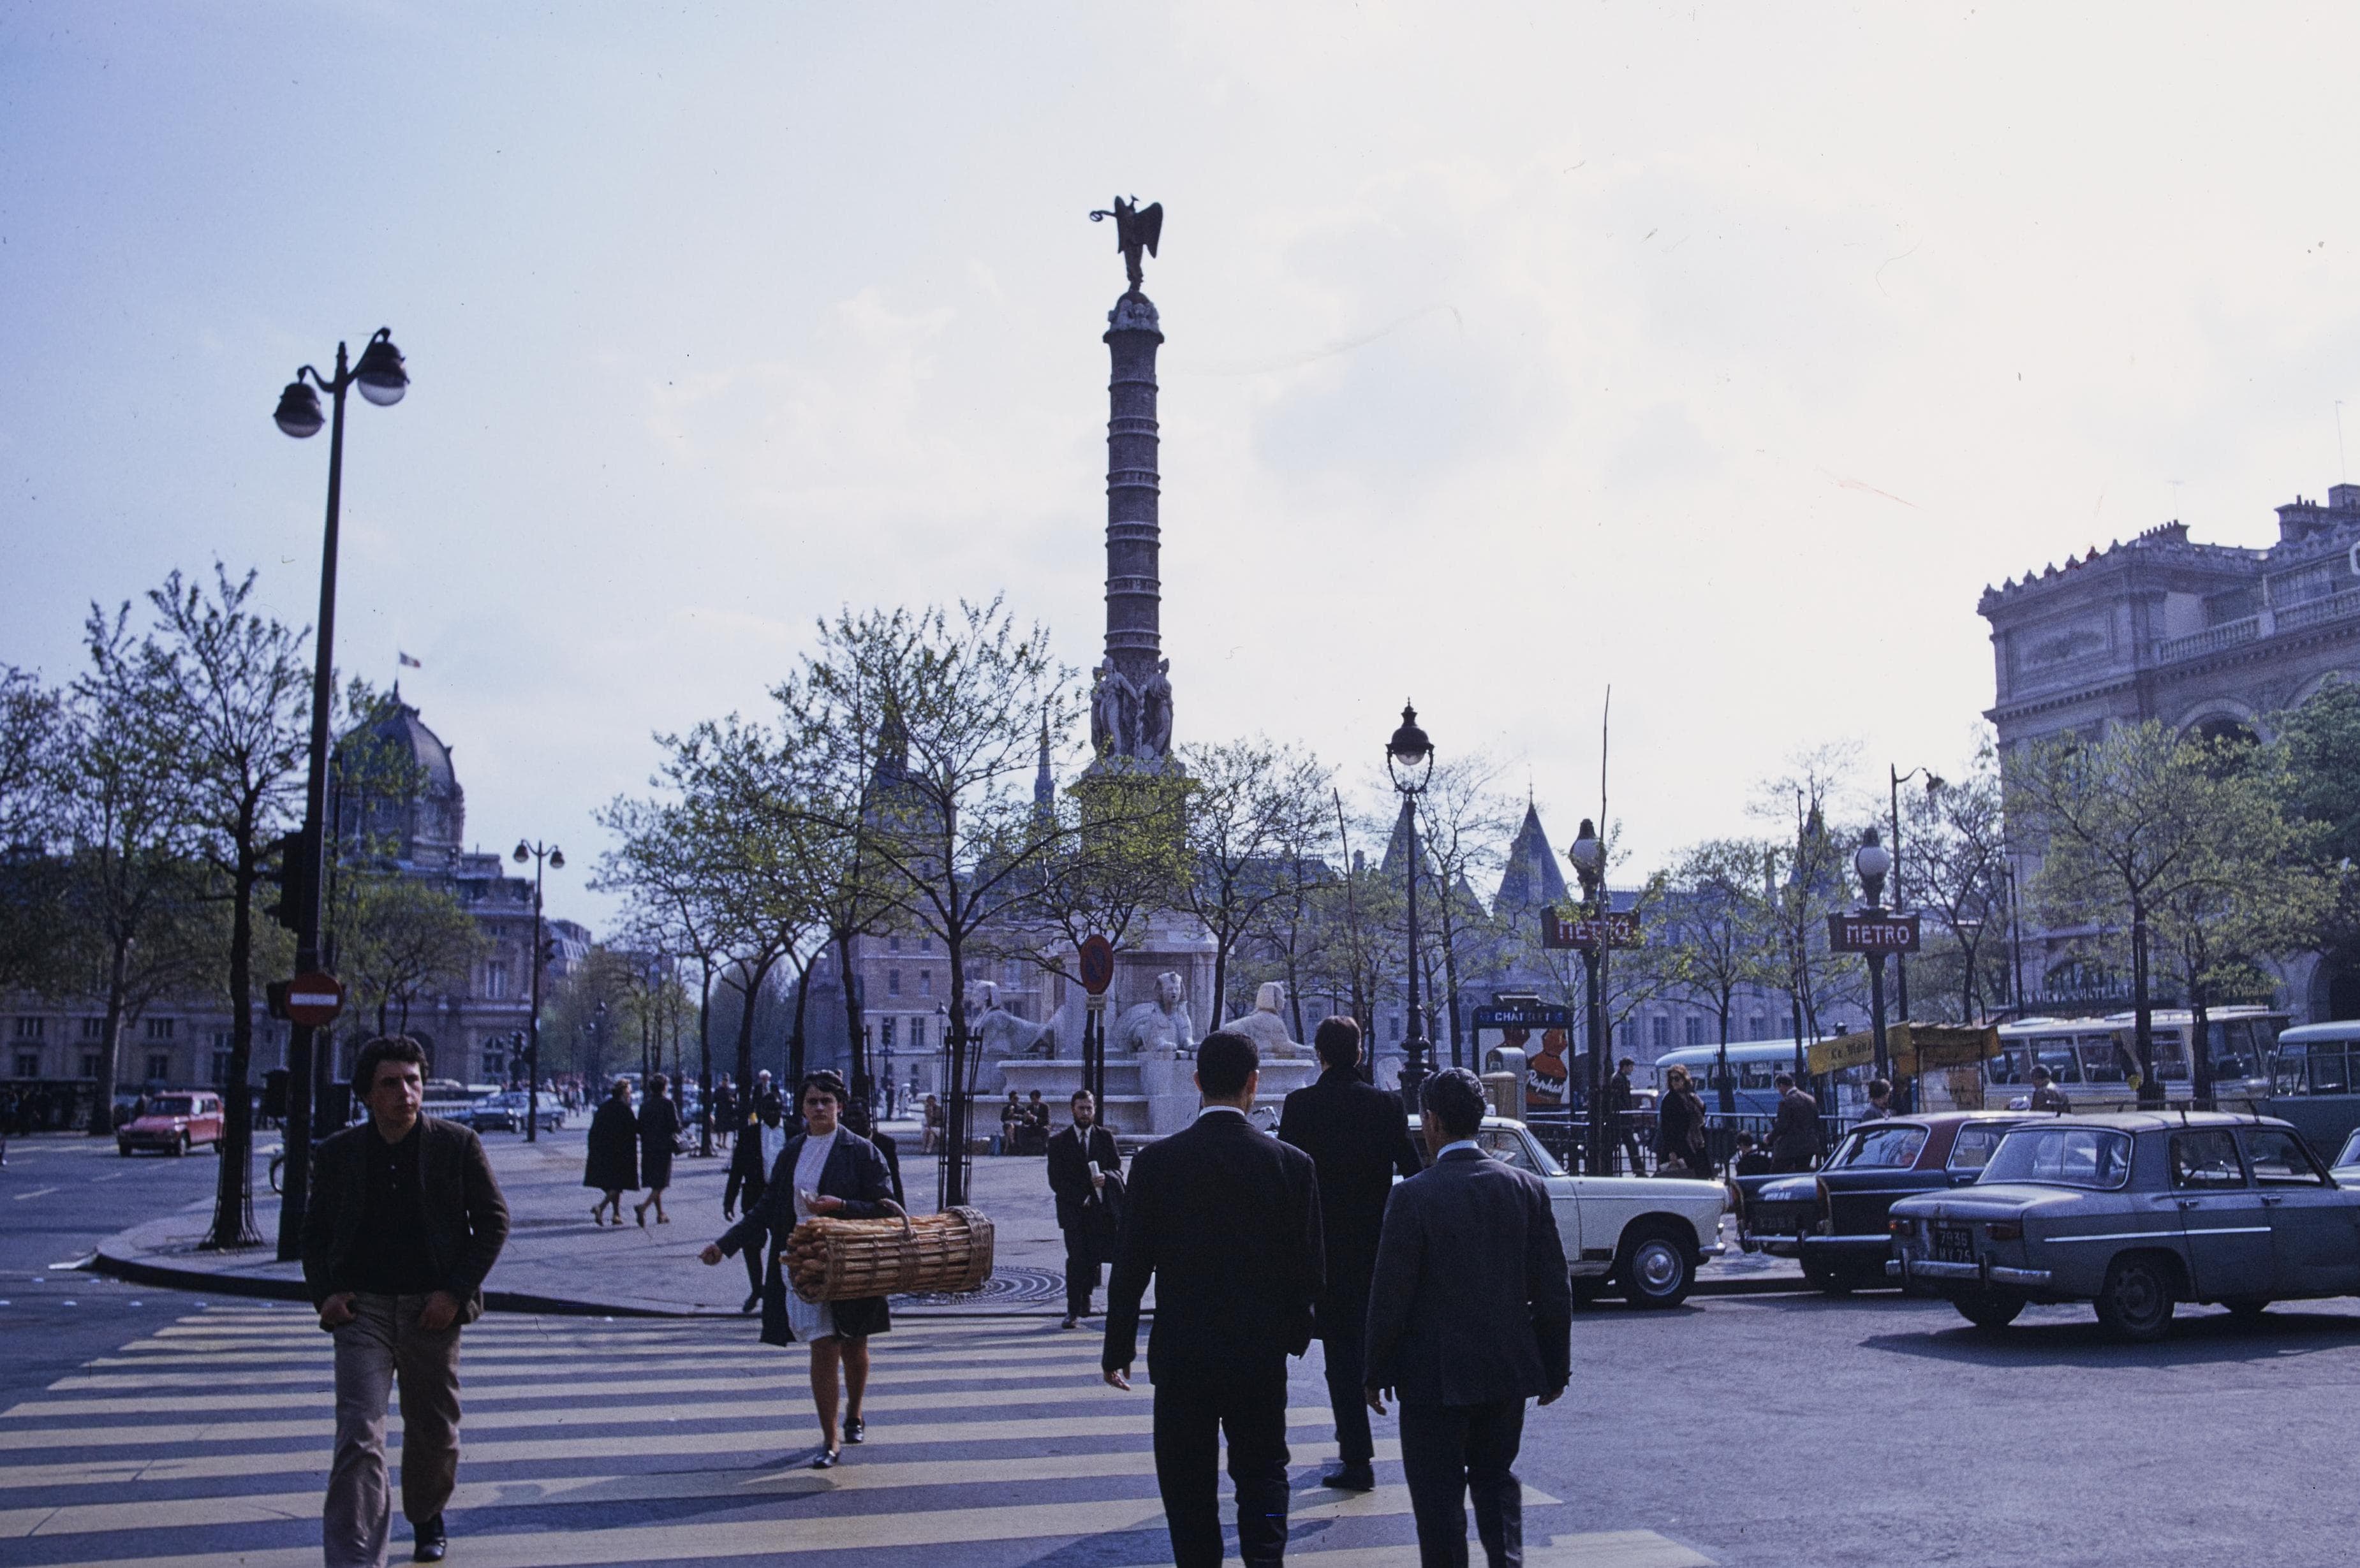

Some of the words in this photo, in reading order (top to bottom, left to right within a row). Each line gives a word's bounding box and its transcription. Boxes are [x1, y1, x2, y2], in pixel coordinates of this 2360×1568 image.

[1559, 918, 1630, 941] METO
[1847, 925, 1910, 944] METRO
[1847, 1039, 1873, 1056] Mond
